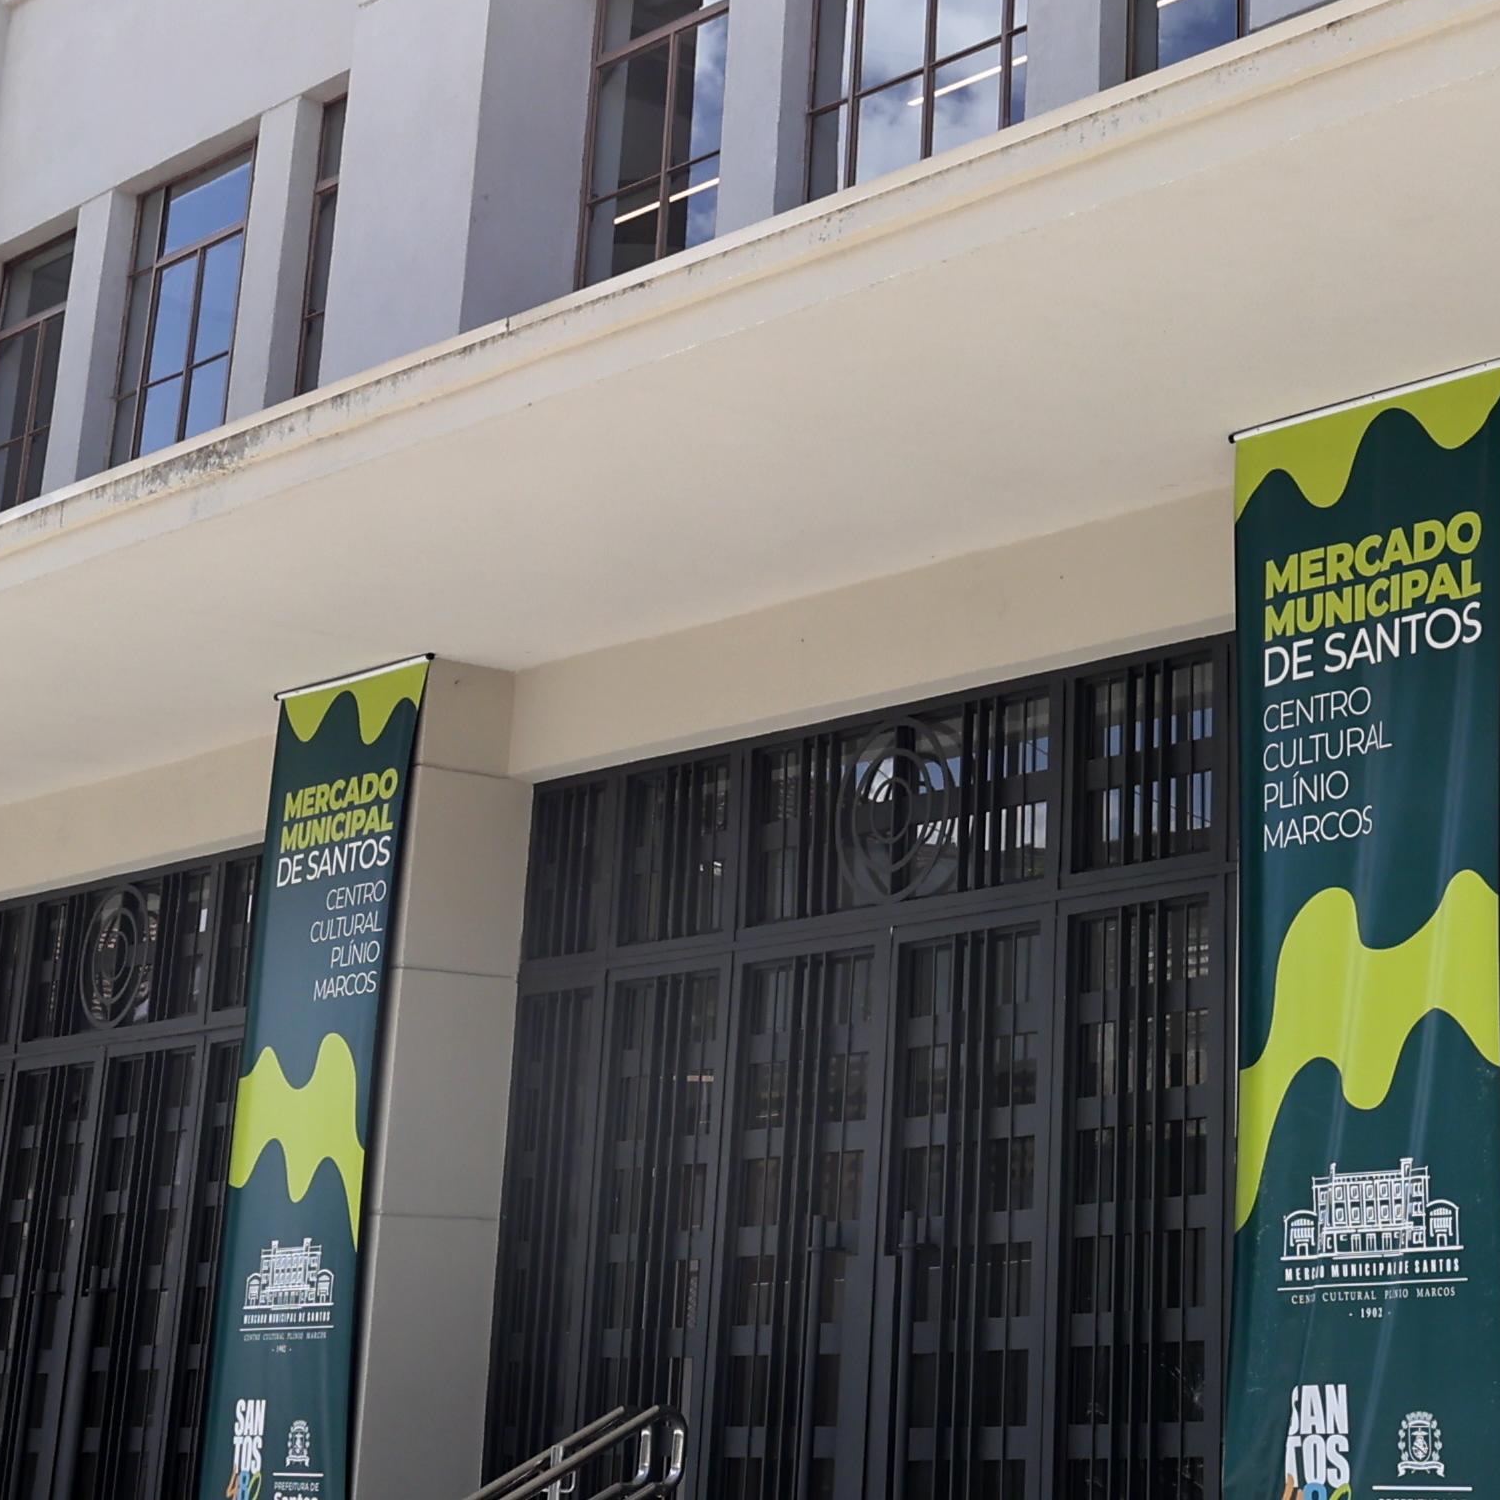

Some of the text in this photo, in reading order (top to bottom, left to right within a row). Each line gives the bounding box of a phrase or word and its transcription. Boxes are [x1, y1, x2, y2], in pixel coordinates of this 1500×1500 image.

[1264, 511, 1483, 600] MERCADO
[1263, 559, 1482, 642] MUNICIPAL
[1263, 601, 1483, 688] DE SANTOS
[1263, 686, 1372, 733] CENTRO
[1263, 721, 1393, 773] CULTURAL
[283, 767, 399, 823] MERCADO
[1263, 770, 1349, 813] PLÍNIO
[280, 803, 394, 854] MUNICIPAL
[1263, 805, 1373, 853] MARCOS
[276, 835, 391, 888] DE SANTOS
[326, 879, 387, 912] CENTRO
[310, 910, 383, 943] CULTURAL
[330, 940, 381, 969] PLÍNIO
[313, 970, 378, 1002] MARCOS
[1414, 1258, 1460, 1274] SANTOS
[1322, 1291, 1377, 1302] CULTURAL
[1416, 1286, 1456, 1298] MARCOS
[307, 1311, 331, 1323] SANTOS
[234, 1398, 266, 1436] SAN
[233, 1435, 263, 1475] TOS
